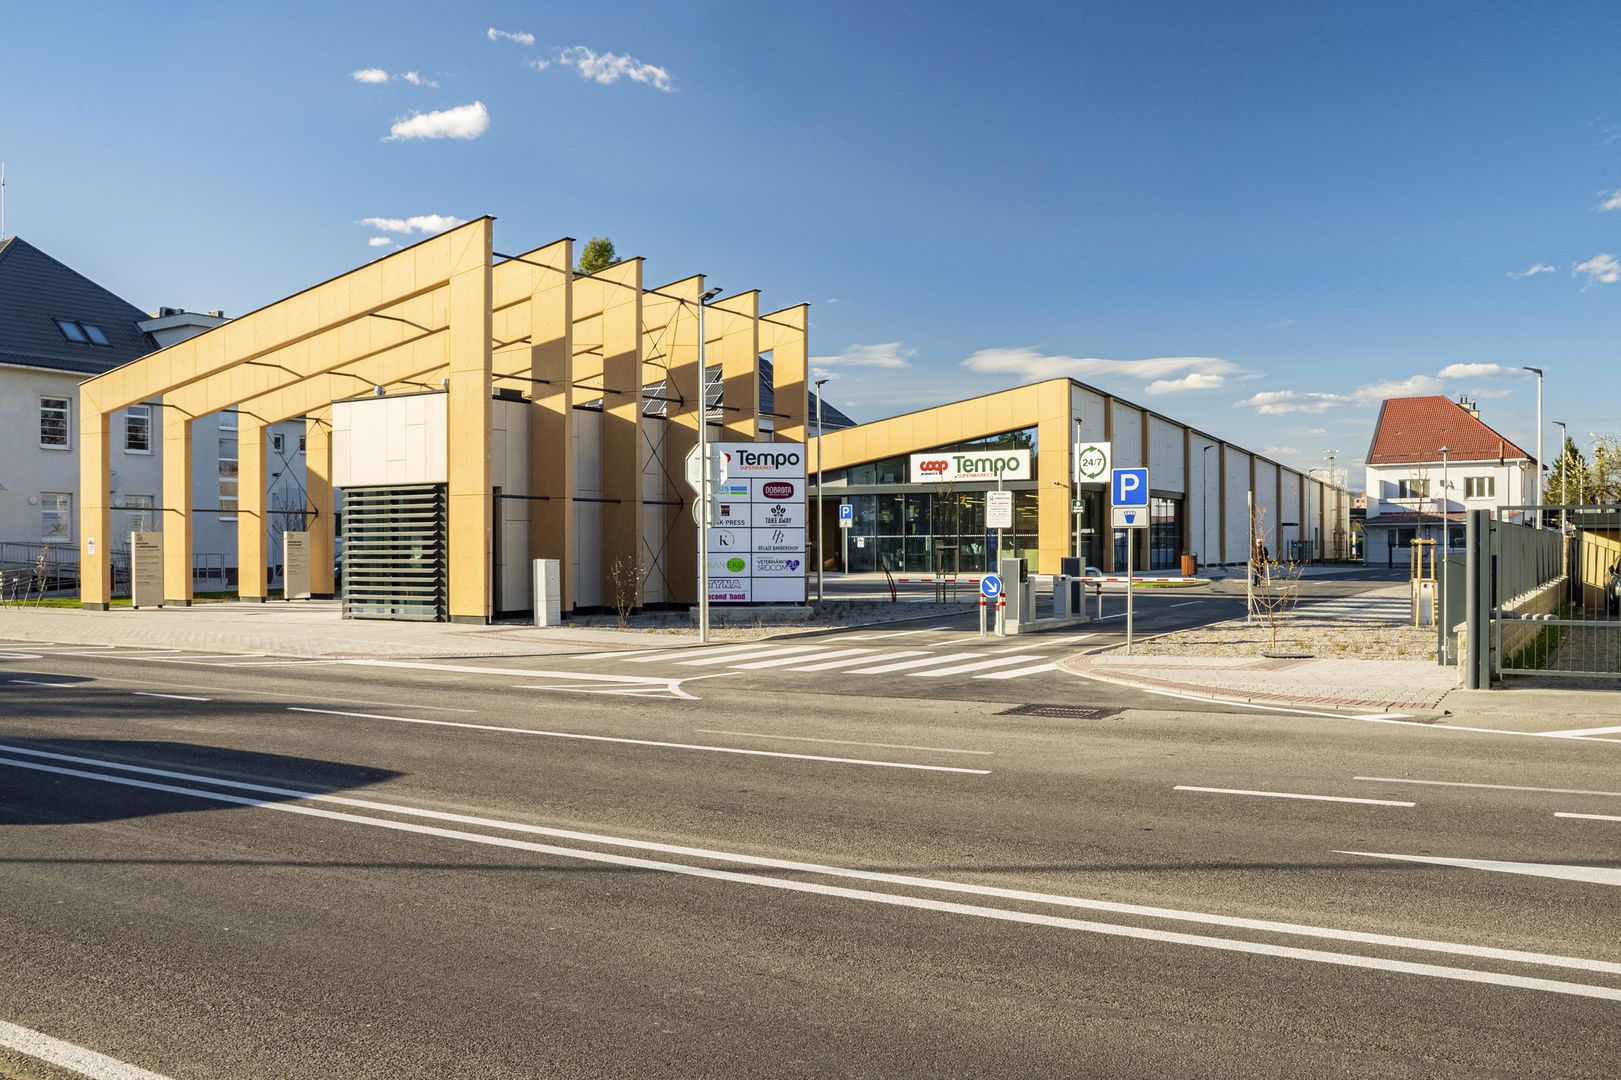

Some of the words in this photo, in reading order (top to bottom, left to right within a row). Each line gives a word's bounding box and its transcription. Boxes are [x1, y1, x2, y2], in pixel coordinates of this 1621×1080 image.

[736, 450, 800, 470] Tempo
[920, 460, 948, 475] coop
[953, 456, 1020, 476] Tempo
[1082, 458, 1102, 467] 24/7
[765, 486, 792, 494] DOBROTA
[1120, 474, 1140, 501] P
[842, 506, 850, 518] P
